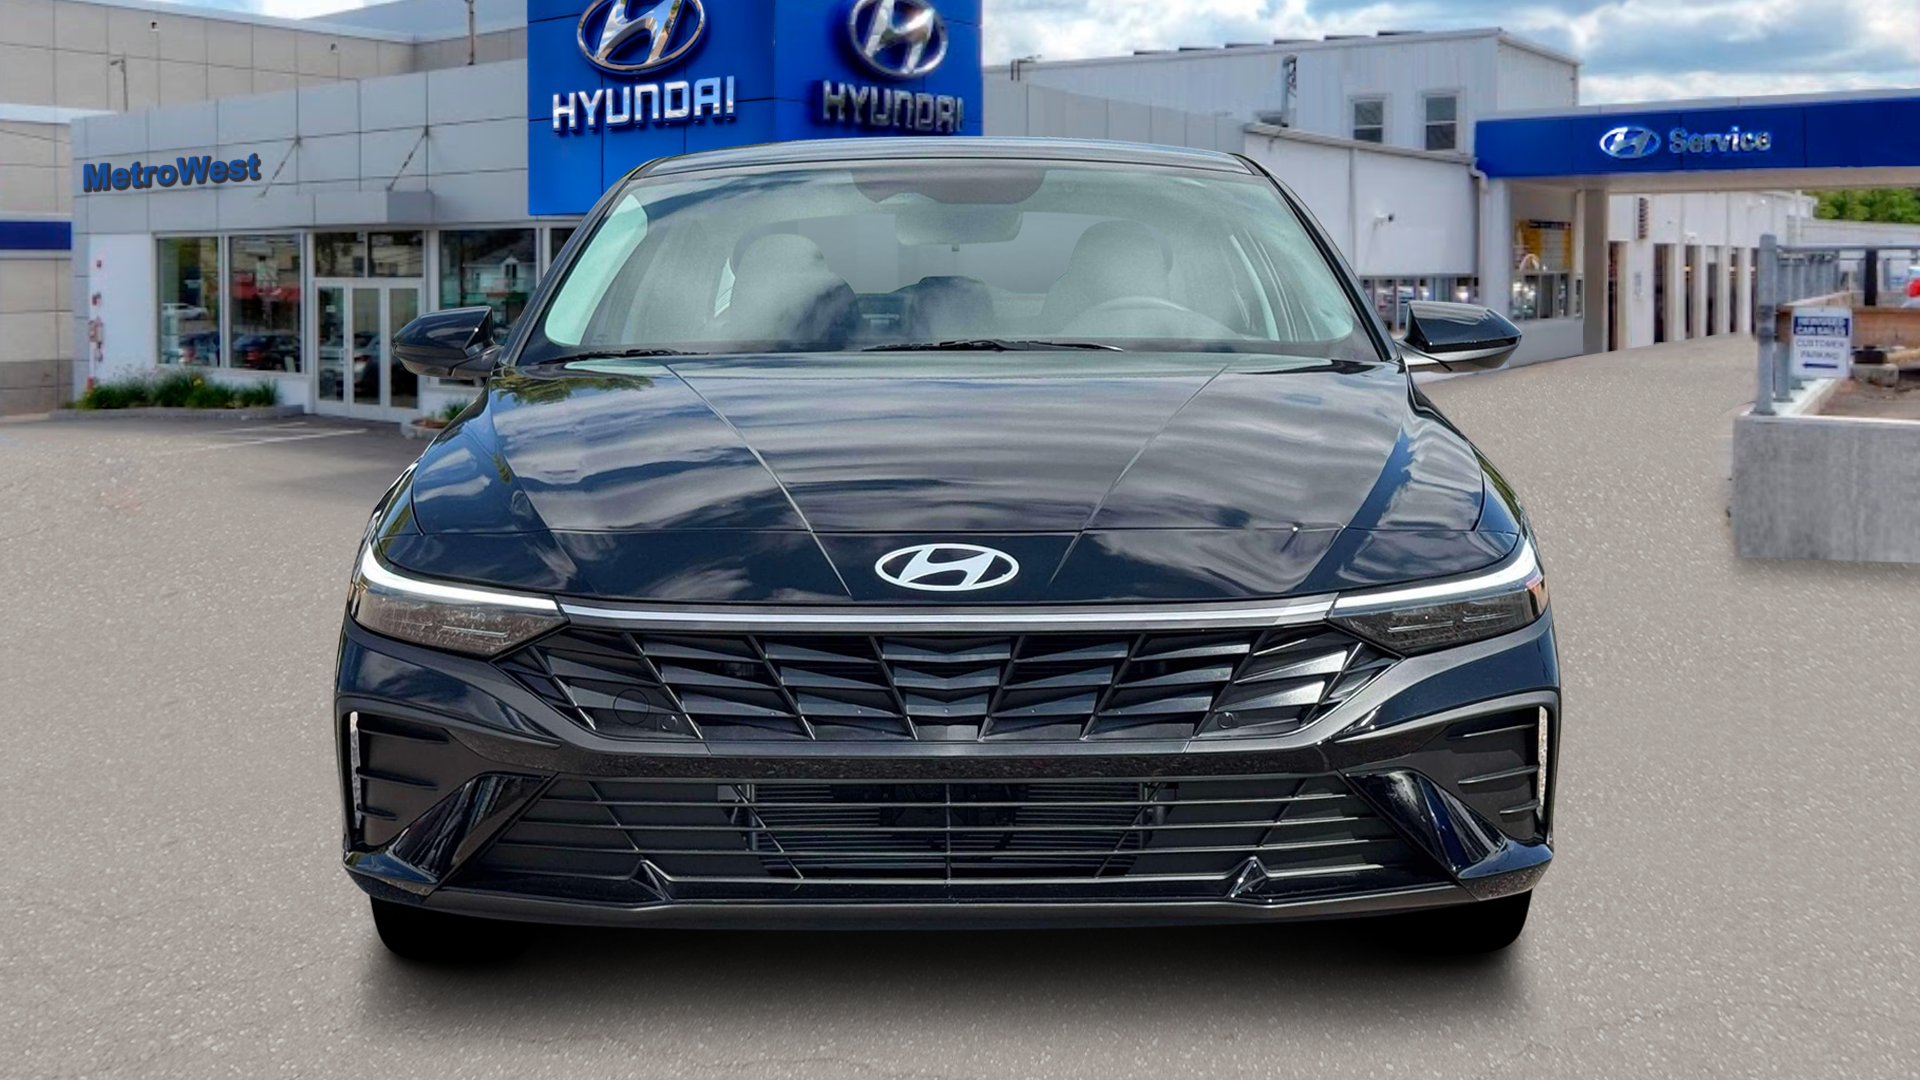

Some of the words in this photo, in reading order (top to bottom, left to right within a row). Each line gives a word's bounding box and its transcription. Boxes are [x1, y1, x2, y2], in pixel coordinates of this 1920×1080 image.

[552, 76, 735, 132] HYUNDAI
[822, 80, 964, 133] HYUNDAI
[1669, 126, 1772, 153] Service
[83, 153, 262, 192] MetroWest
[1797, 339, 1844, 348] CUSTOMER
[1801, 350, 1839, 360] PARKING
